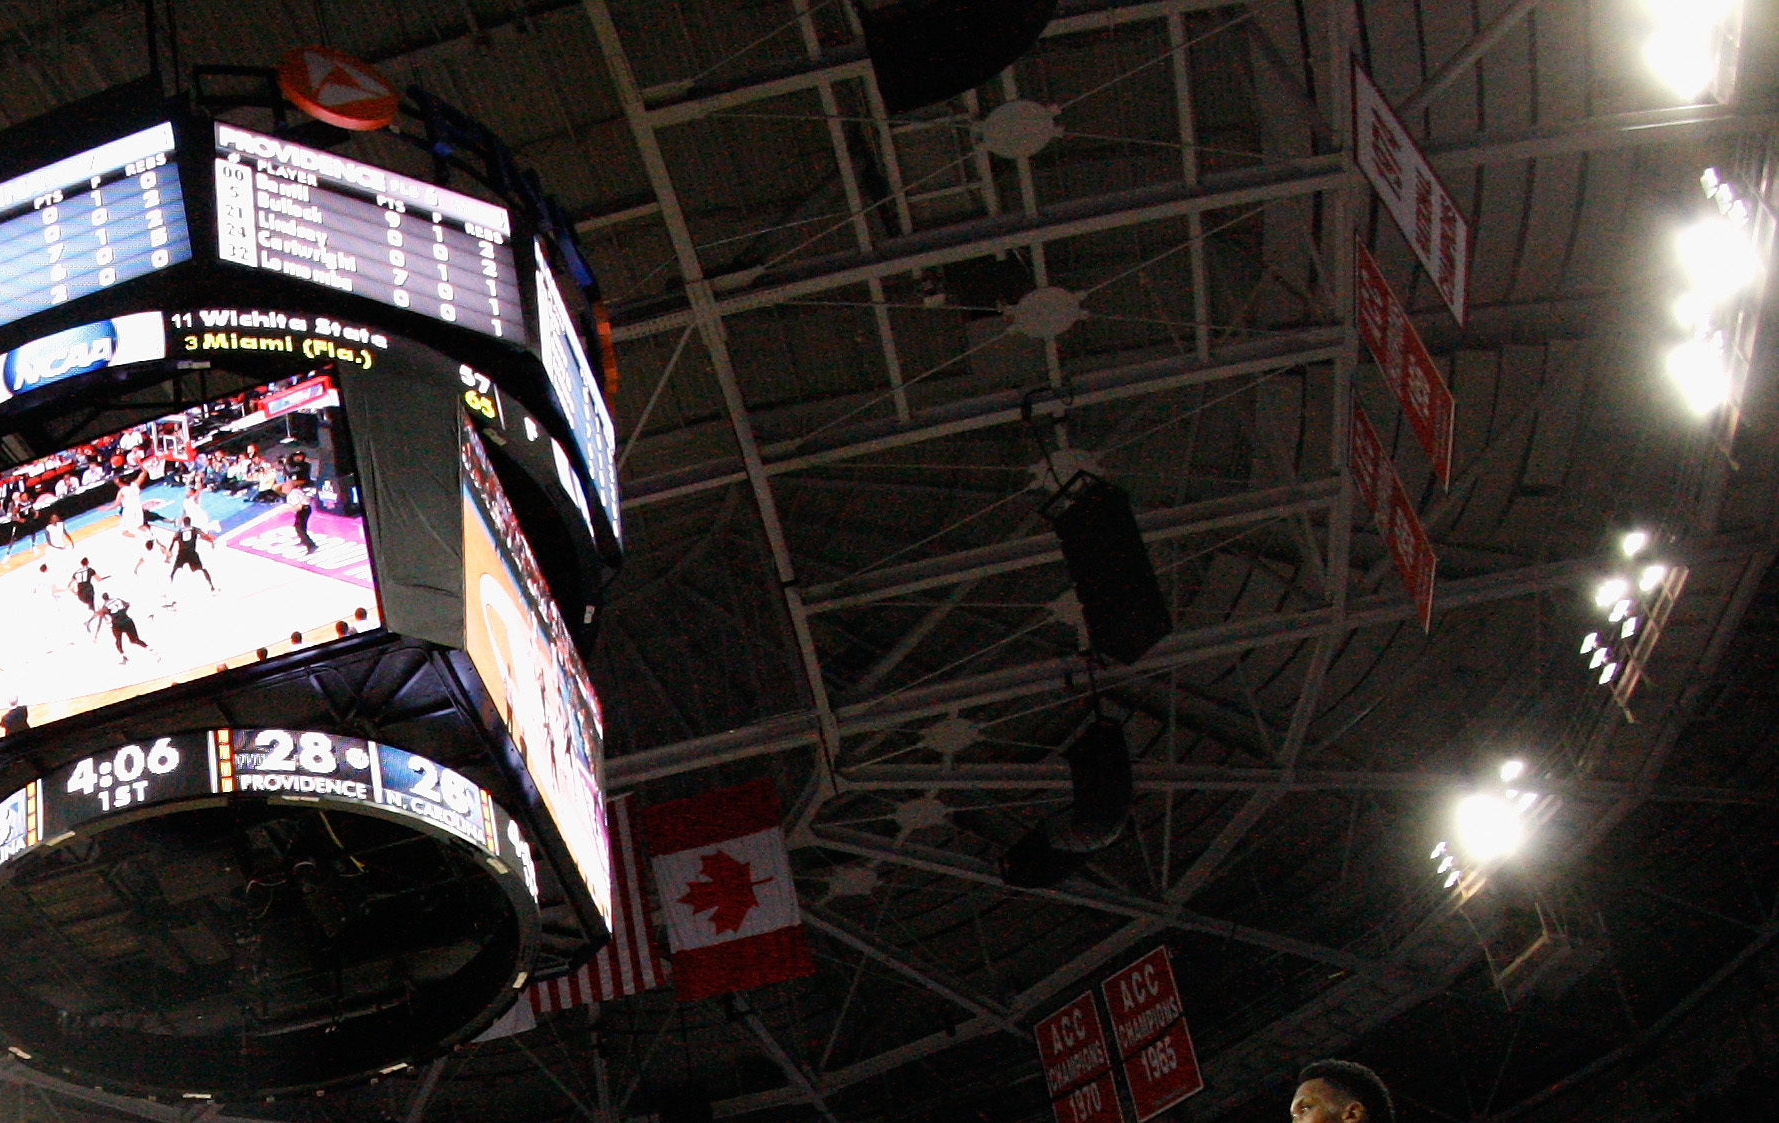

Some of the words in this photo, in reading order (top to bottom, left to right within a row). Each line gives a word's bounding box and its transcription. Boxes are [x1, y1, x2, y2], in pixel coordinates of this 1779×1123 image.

[219, 125, 387, 193] PROVIDENCE
[33, 189, 64, 209] PTS
[42, 206, 60, 225] 0
[90, 189, 103, 207] 1
[139, 170, 158, 190] 0
[257, 158, 319, 188] PLAYER
[377, 194, 406, 213] PTS
[43, 225, 62, 244] 0
[91, 208, 109, 226] 0
[142, 191, 160, 209] 2
[48, 242, 65, 264] 7
[94, 228, 108, 246] 1
[144, 209, 164, 230] 2
[222, 165, 245, 182] 00
[432, 225, 444, 243] 1
[478, 241, 496, 260] 2
[50, 284, 69, 306] 2
[98, 266, 117, 287] 0
[150, 249, 170, 269] 0
[95, 247, 114, 266] 0
[386, 229, 404, 248] 0
[433, 243, 449, 262] 0
[481, 259, 499, 279] 2
[388, 249, 405, 269] 0
[436, 263, 449, 282] 1
[484, 278, 498, 297] 1
[392, 268, 409, 287] 7
[437, 282, 455, 301] 0
[488, 298, 501, 317] 1
[393, 289, 411, 308] 0
[439, 303, 457, 322] 0
[490, 318, 503, 337] 1
[172, 312, 193, 330] 11
[199, 309, 308, 332] Wichita
[314, 316, 389, 350] State
[184, 336, 199, 352] 3
[202, 332, 294, 353] Miami
[302, 337, 373, 371] (Fla.)
[14, 337, 112, 392] NCAA
[464, 389, 496, 420] 65
[66, 737, 181, 796] 4:06
[254, 728, 339, 774] 28
[98, 779, 149, 813] 1ST
[239, 773, 369, 801] PROVIDENCE
[407, 753, 473, 815] 28
[385, 789, 409, 811] N.
[410, 796, 487, 846] CAROLINA
[1121, 962, 1161, 1013] ACC
[1050, 1007, 1087, 1057] ACC
[1117, 994, 1180, 1050] CHAMPIONS
[1046, 1039, 1106, 1093] CHAMPIONS
